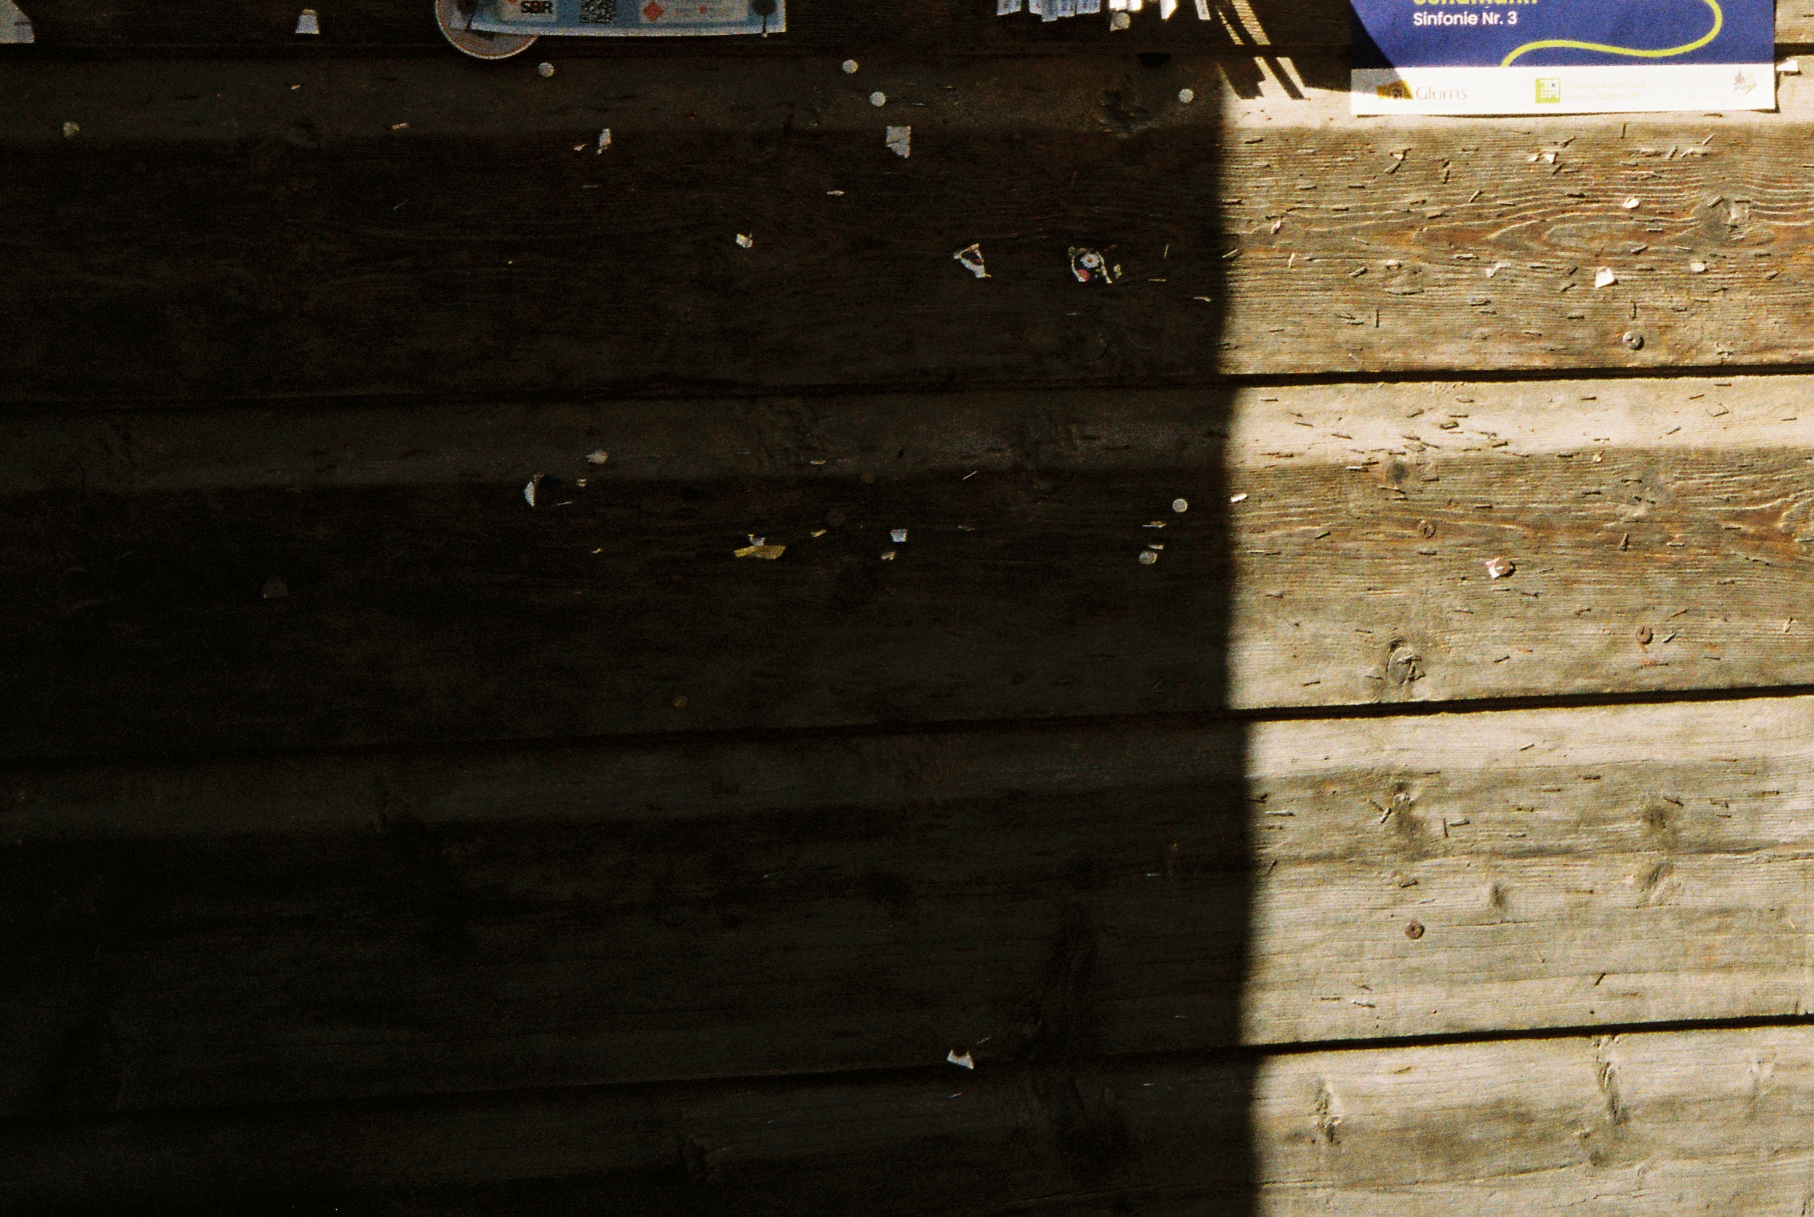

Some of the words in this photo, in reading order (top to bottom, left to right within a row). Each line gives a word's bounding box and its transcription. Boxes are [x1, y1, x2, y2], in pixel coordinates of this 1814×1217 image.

[1413, 12, 1478, 27] Sinfonie
[1482, 13, 1504, 27] Nr.
[1507, 13, 1518, 27] 3
[1415, 85, 1468, 101] Glurns
